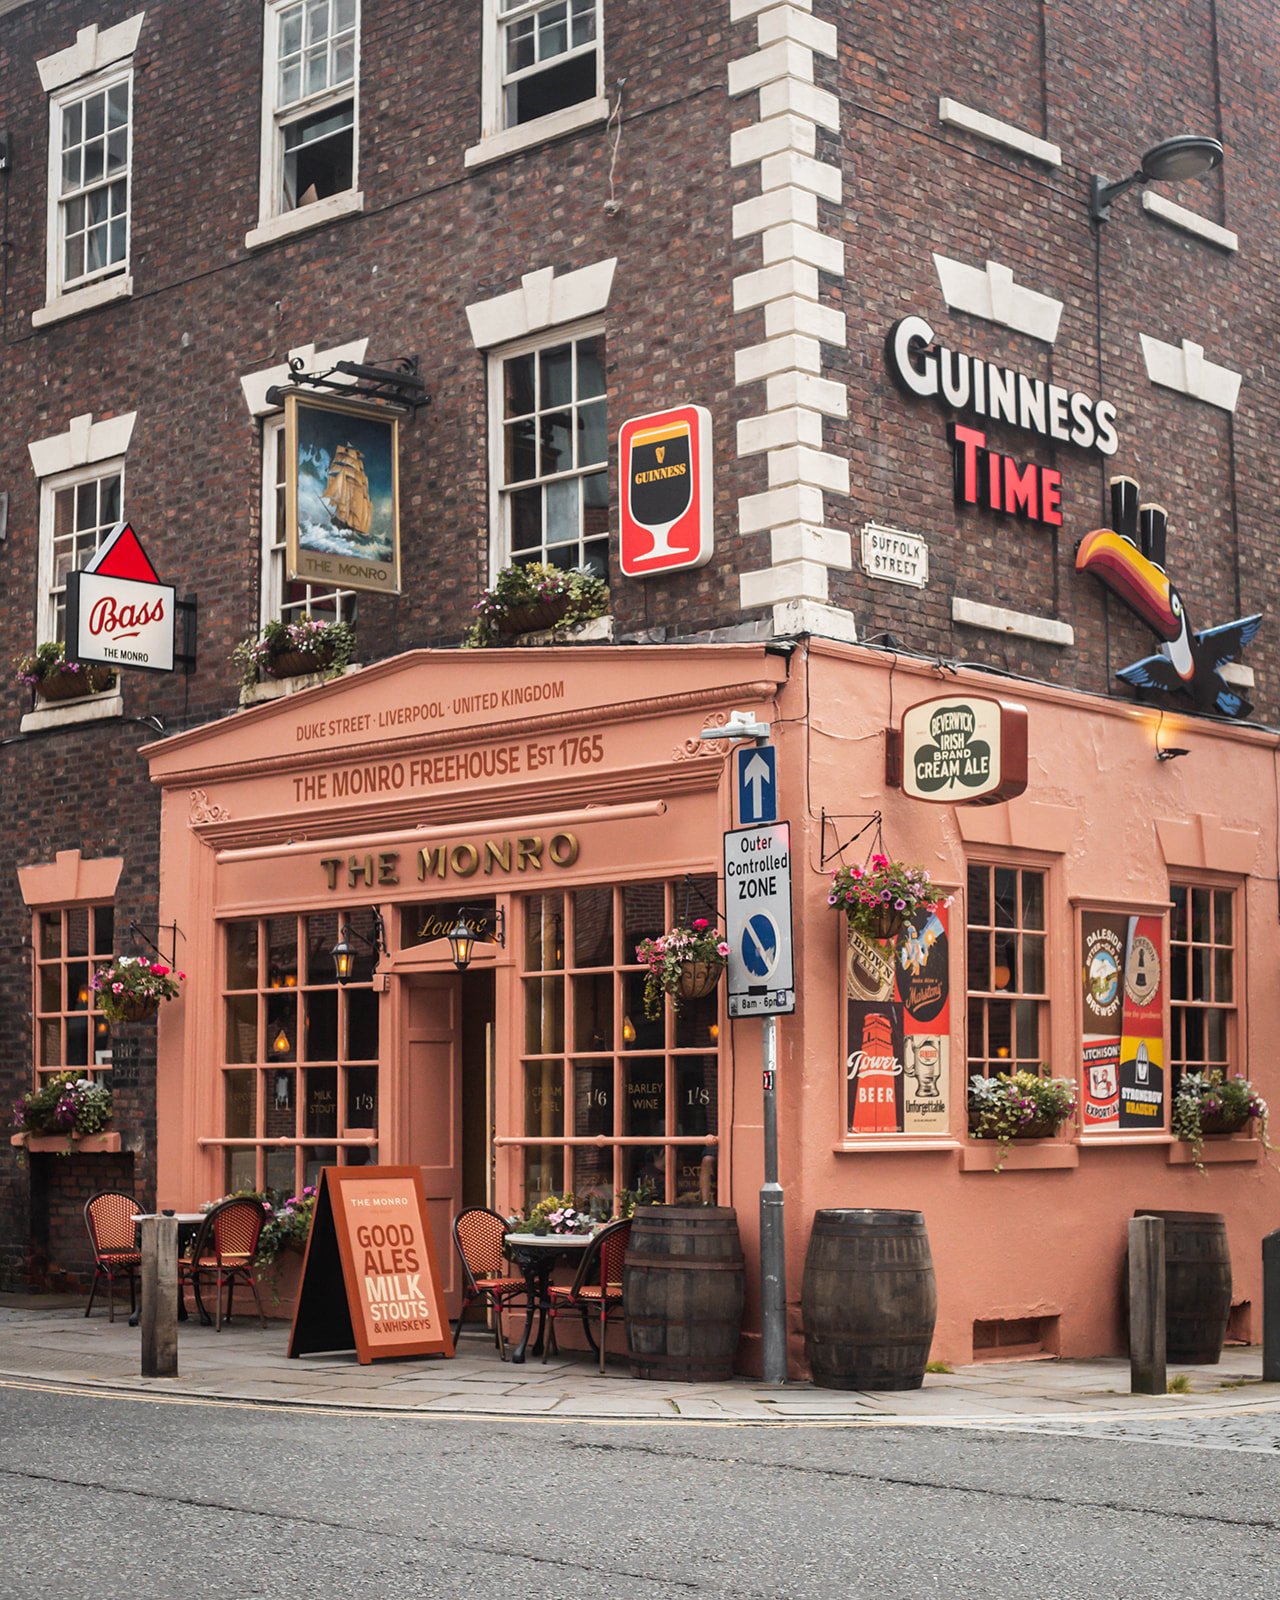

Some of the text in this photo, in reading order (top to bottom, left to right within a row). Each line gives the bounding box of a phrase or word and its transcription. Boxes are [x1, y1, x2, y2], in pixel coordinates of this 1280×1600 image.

[889, 315, 1119, 456] GUINNESS
[635, 463, 686, 485] GUINNESS
[952, 424, 1063, 527] TIME
[872, 535, 920, 559] SUFFOLK
[306, 558, 387, 581] THE MONRO
[875, 555, 917, 576] STREET
[89, 597, 164, 635] Bass
[104, 648, 149, 662] THE MONRO
[296, 680, 564, 742] DUKE STREET LIVERPOOL UNITED KINGDOM
[940, 732, 965, 750] IRISH
[933, 749, 971, 761] BRAND
[293, 774, 327, 802] THE
[332, 763, 405, 798] MONRO
[410, 746, 520, 786] FREEHOUSE
[559, 734, 604, 766] 1765
[916, 756, 989, 779] CREAM ALE
[741, 836, 772, 853] Outer
[320, 831, 579, 890] THE MONRO
[727, 853, 787, 877] Controlled
[738, 876, 777, 899] ZONE
[1086, 928, 1122, 952] DALESIDE
[853, 934, 893, 978] BROWN
[742, 998, 757, 1009] 8am
[1086, 993, 1120, 1017] BREWERY
[313, 1090, 332, 1100] MILK
[532, 1086, 562, 1097] CRAM
[628, 1082, 664, 1094] BARLEY
[859, 1087, 894, 1103] BEER
[310, 1104, 336, 1114] STOUT
[633, 1098, 659, 1110] WINE
[906, 1100, 945, 1116] Unforgettable
[1086, 1103, 1110, 1119] EXPORT
[683, 1166, 714, 1177] EXTA
[351, 1197, 408, 1207] THE MONRO
[357, 1224, 414, 1248] GOOD
[364, 1249, 420, 1275] ALES
[365, 1274, 425, 1302] MILK
[370, 1301, 429, 1321] STOUTS
[374, 1319, 431, 1333] & WHISKEYS
